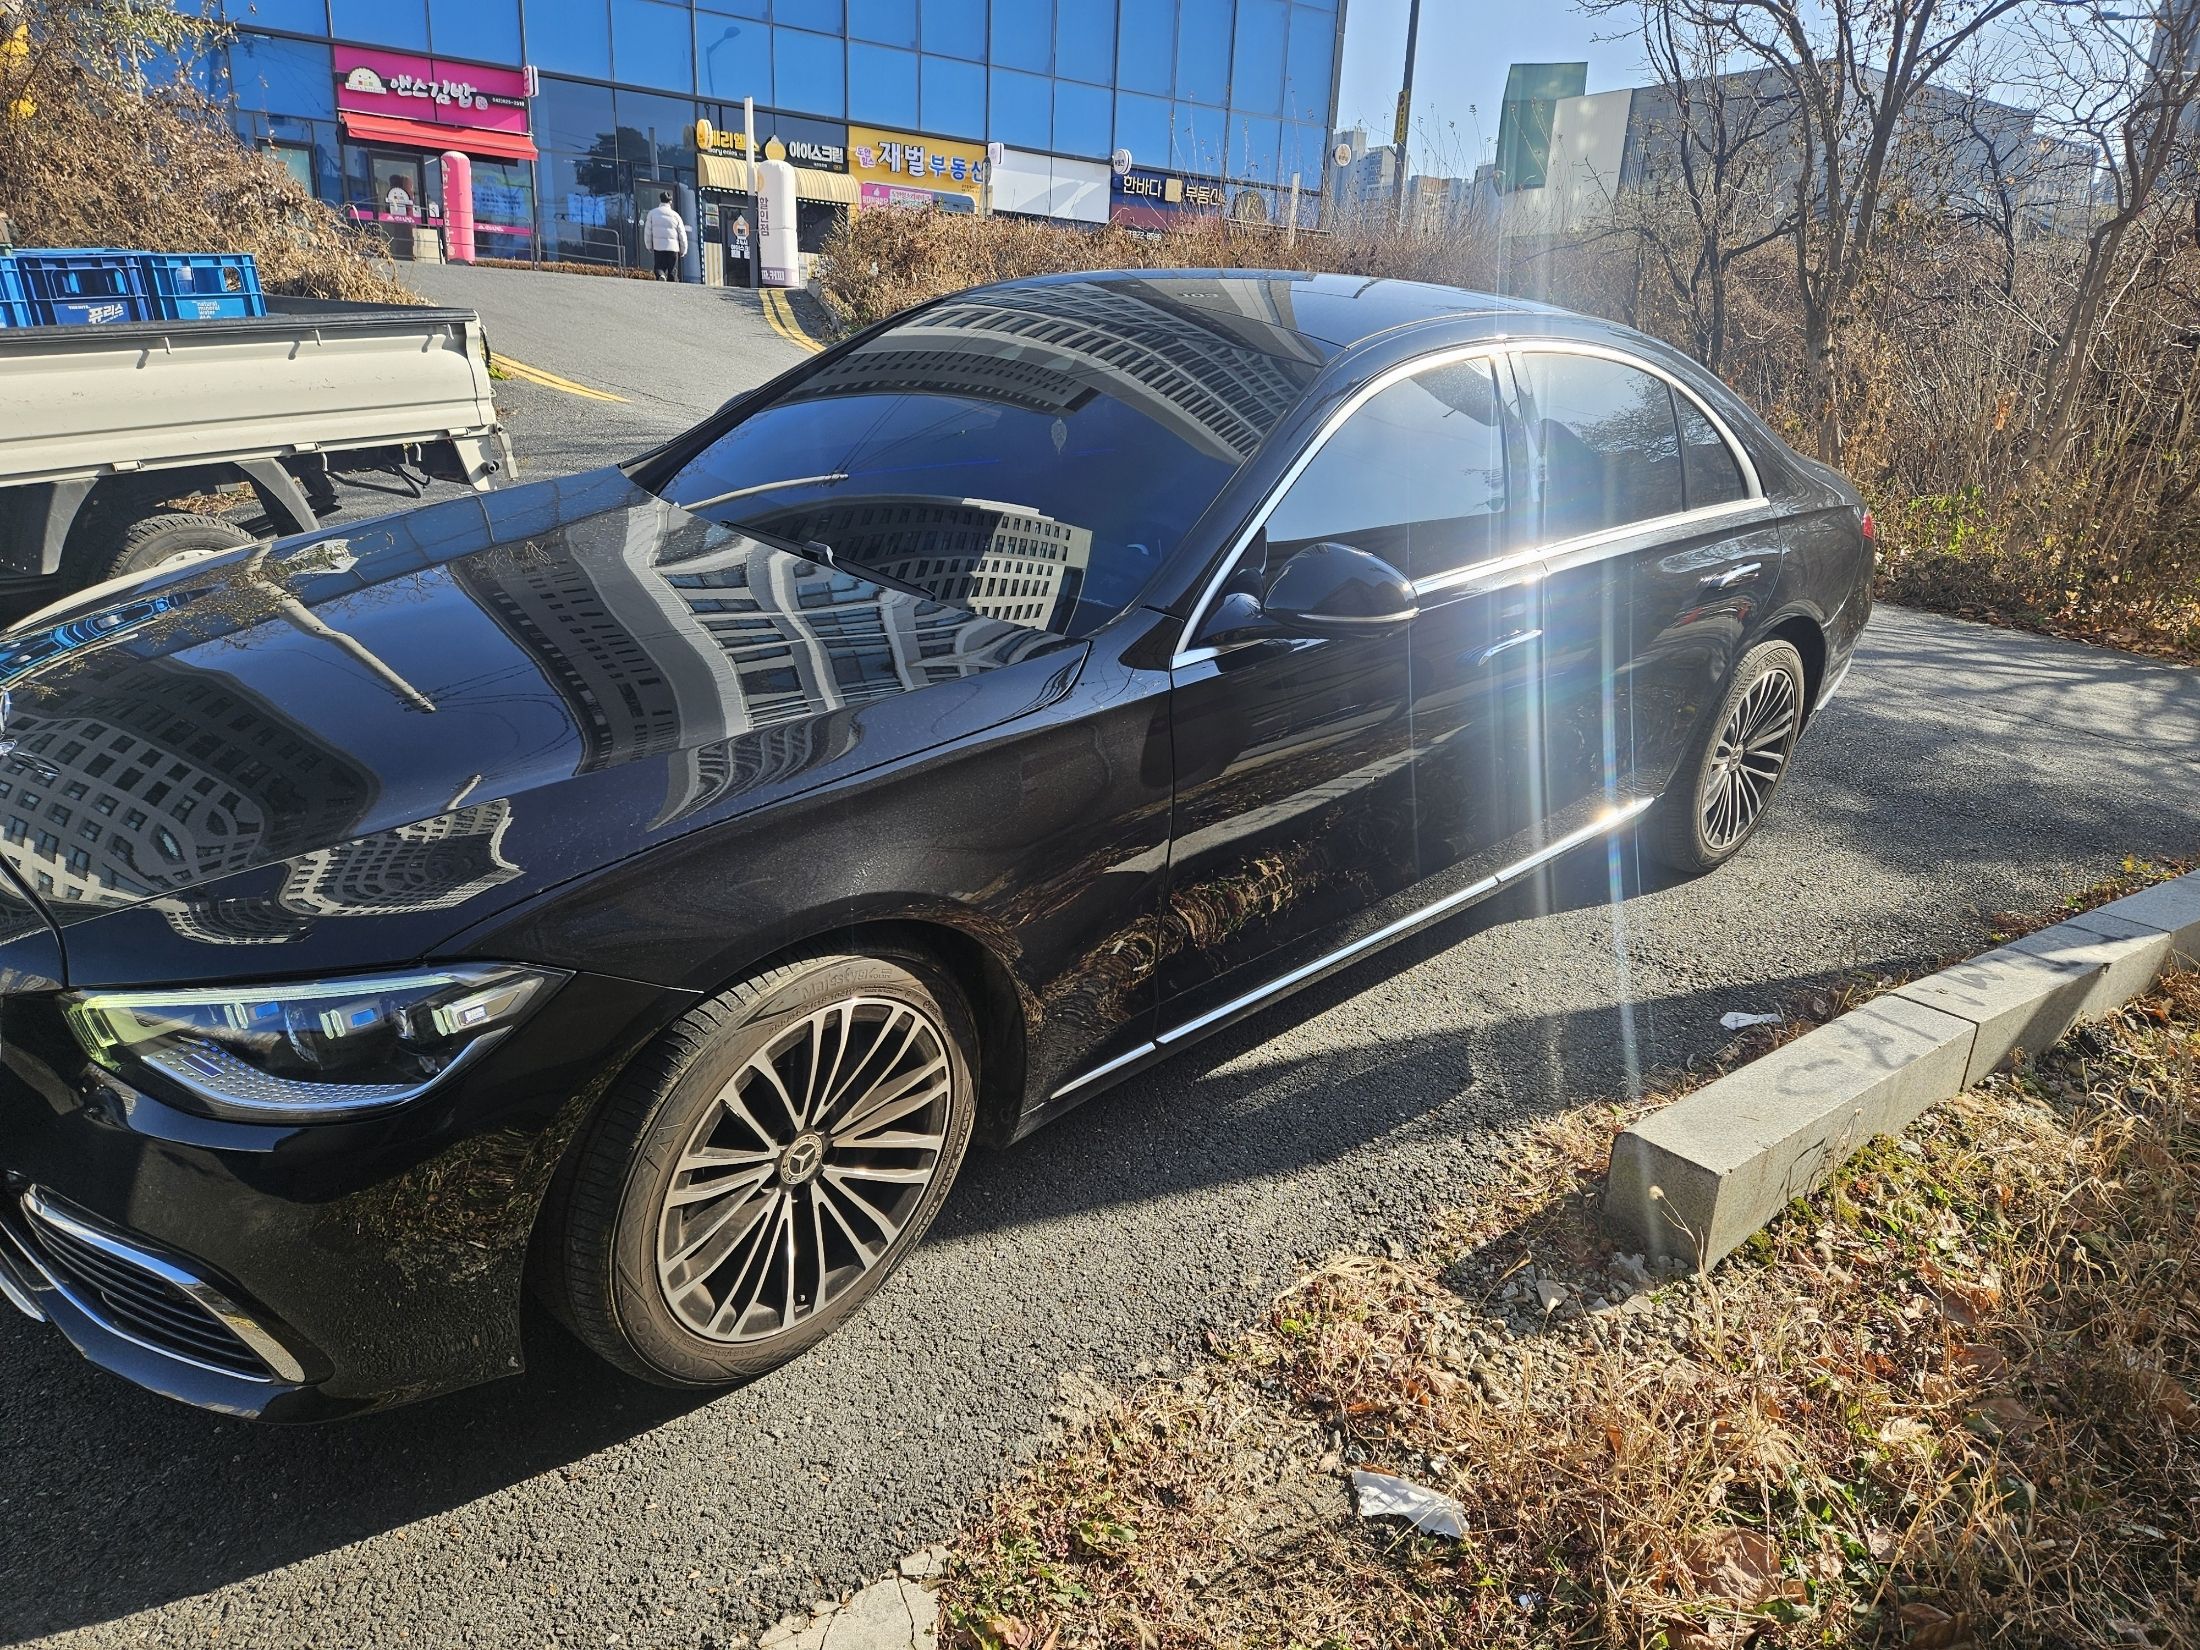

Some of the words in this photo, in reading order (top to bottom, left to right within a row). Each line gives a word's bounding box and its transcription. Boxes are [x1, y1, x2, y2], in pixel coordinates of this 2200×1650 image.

[391, 74, 477, 109] 앤스김밥
[877, 141, 926, 178] 재벌
[929, 154, 984, 184] 부동산
[1123, 175, 1162, 198] 한바다
[1185, 184, 1225, 206] 부동산
[88, 303, 124, 324] 퓨리스
